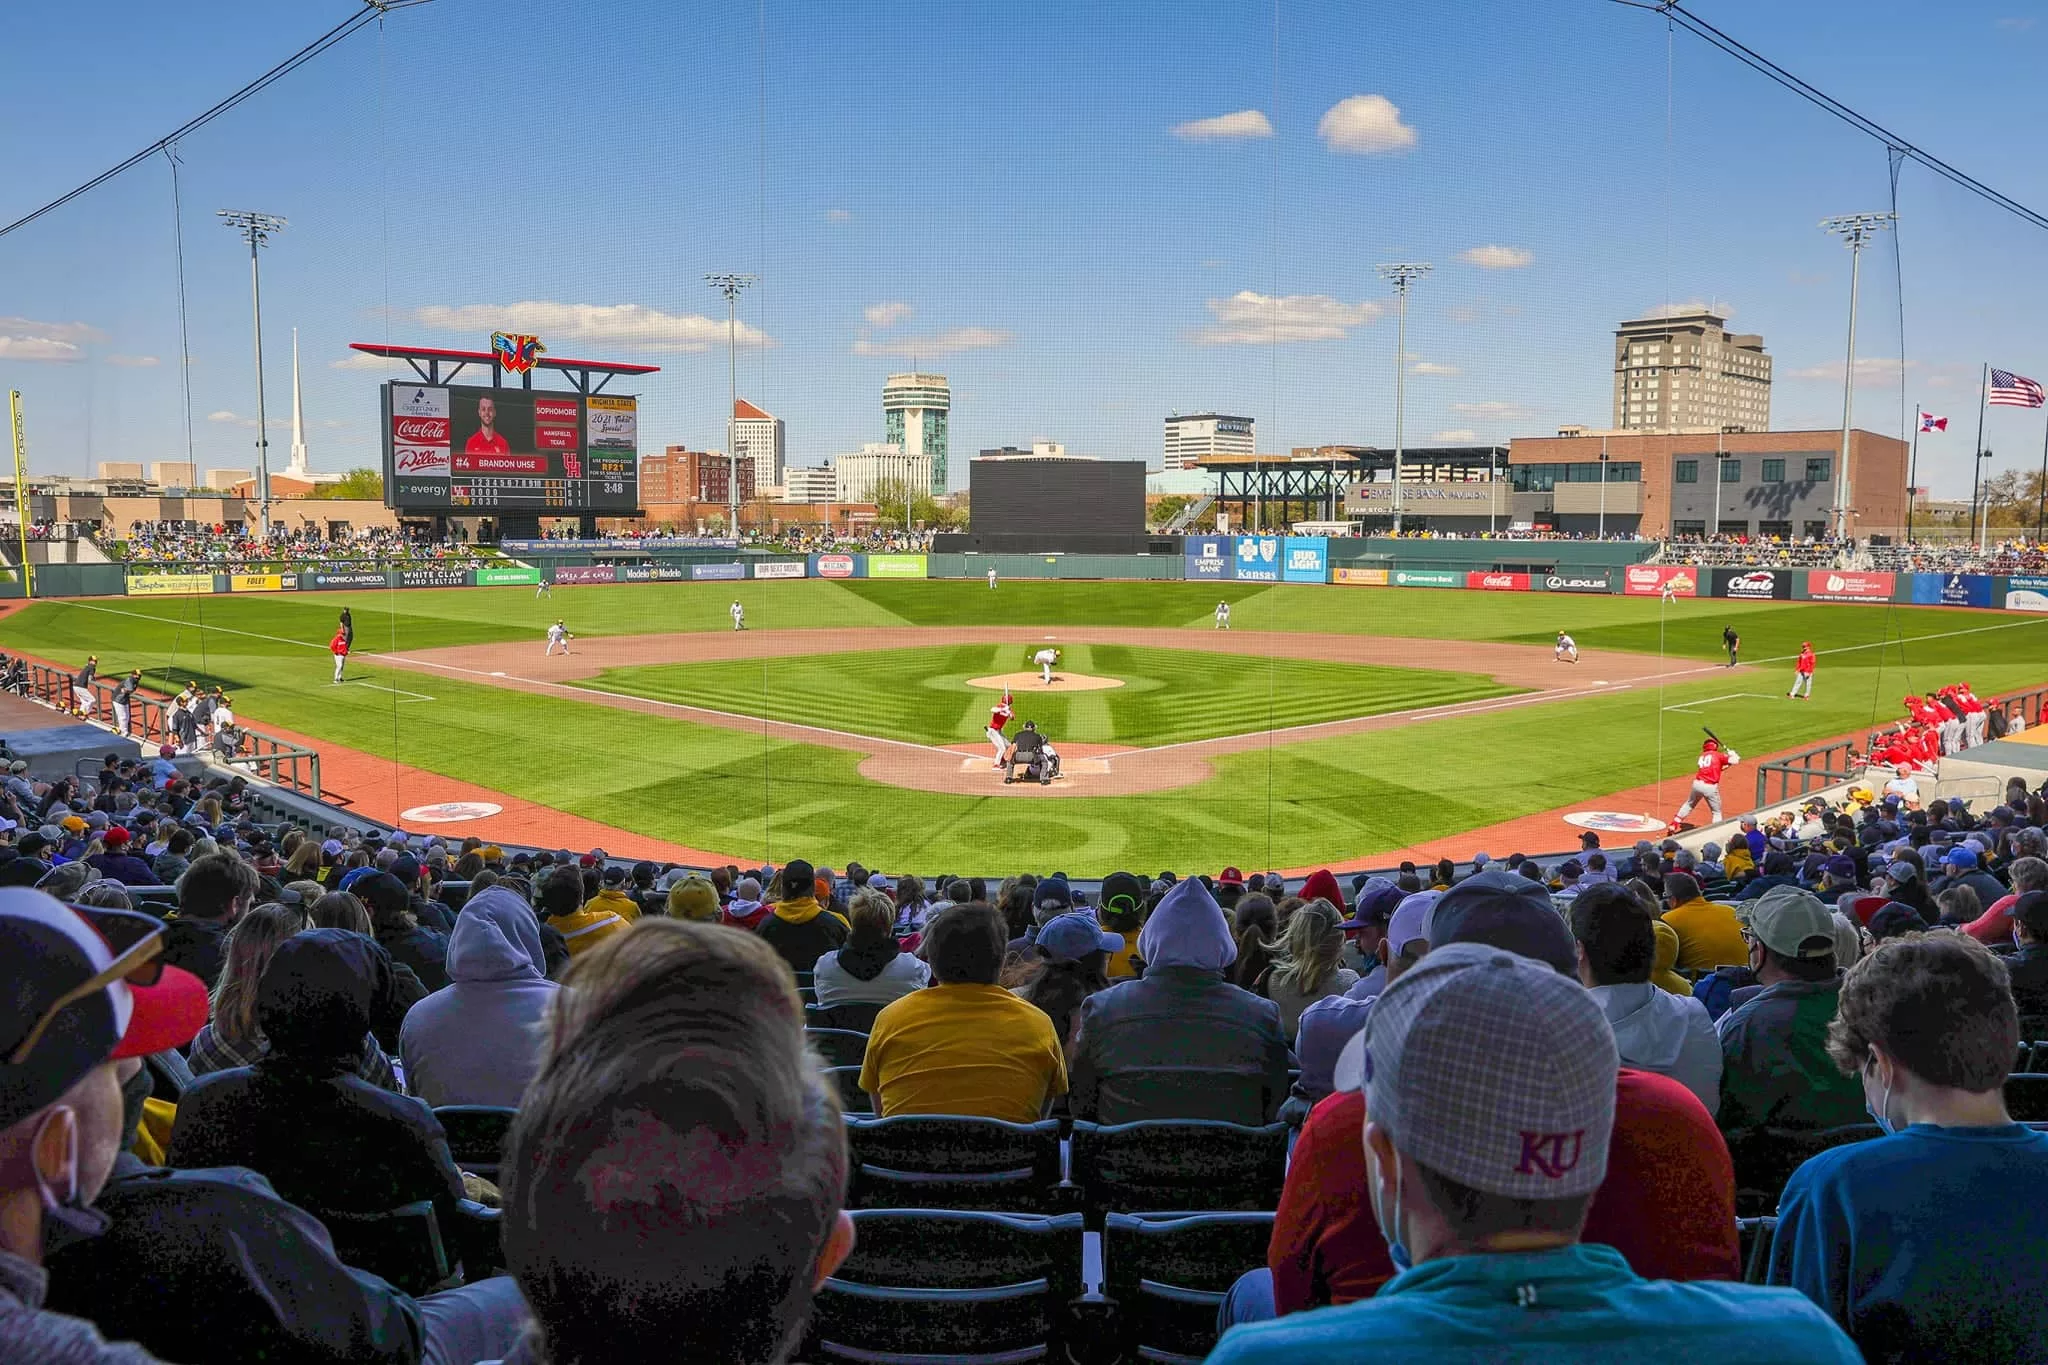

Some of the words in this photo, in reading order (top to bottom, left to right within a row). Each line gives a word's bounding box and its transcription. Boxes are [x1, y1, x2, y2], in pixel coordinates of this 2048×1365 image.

[536, 408, 577, 416] SOPHOMORE
[592, 414, 611, 423] 2021
[543, 430, 572, 438] MANSFIELD,
[394, 449, 450, 471] Dillons
[456, 457, 470, 468] #4
[478, 459, 516, 468] BRANDON
[517, 459, 536, 469] UHSE
[411, 485, 447, 496] evergy
[603, 482, 624, 494] 3:48
[1370, 489, 1413, 500] EMPSE
[1416, 489, 1446, 500] BANK
[1448, 492, 1487, 500] PAVILION
[1293, 550, 1316, 560] BUD
[1194, 559, 1224, 567] EMPRISE
[1288, 559, 1321, 570] LIGHT
[627, 569, 650, 579] Modelo
[659, 568, 682, 578] Modelo
[758, 565, 770, 574] OUR
[1237, 569, 1276, 579] Kansas
[326, 576, 355, 584] KONICA
[355, 575, 385, 583] MINOLTA
[402, 571, 434, 580] WHITE
[437, 570, 463, 579] CLAW
[246, 577, 266, 585] FOLEY
[282, 577, 296, 587] CAT
[1562, 580, 1607, 588] LEXUS
[1727, 576, 1774, 591] Club
[1513, 1129, 1586, 1179] KU
